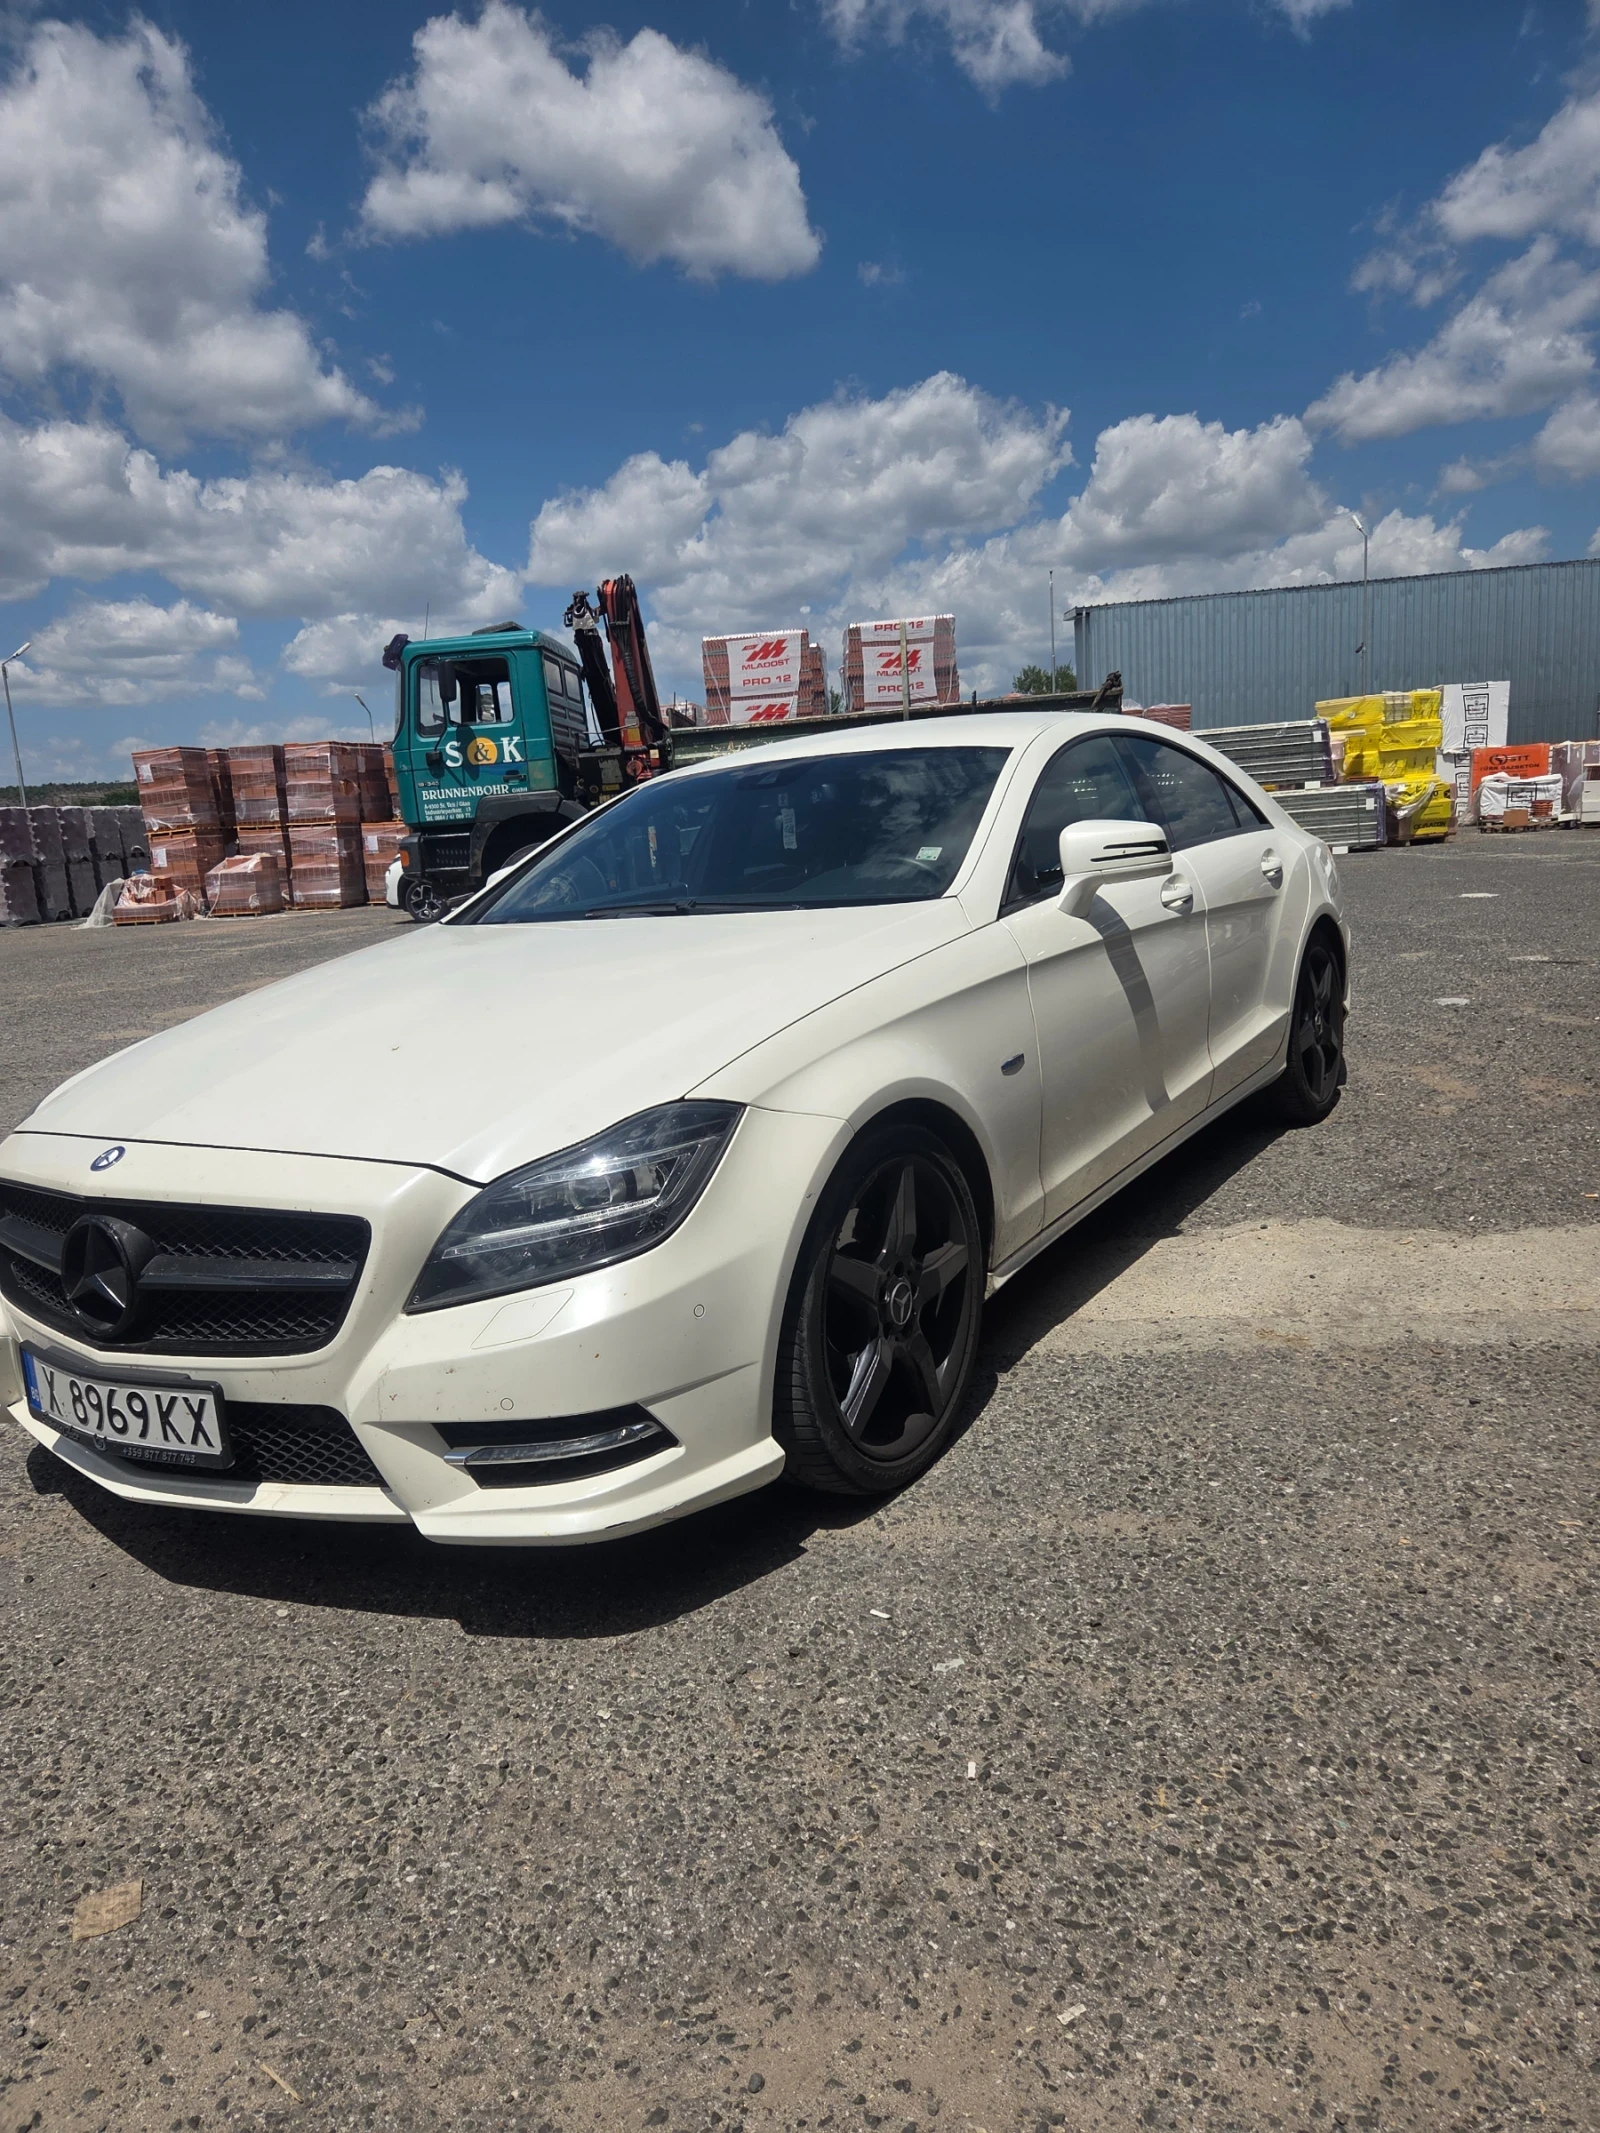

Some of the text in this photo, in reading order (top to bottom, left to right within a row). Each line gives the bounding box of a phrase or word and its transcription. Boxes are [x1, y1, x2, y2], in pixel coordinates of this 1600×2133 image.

[909, 621, 923, 630] 12
[741, 658, 790, 671] MLADOST
[742, 674, 791, 687] PRO 12
[909, 682, 924, 691] 12
[445, 736, 525, 768] S & K
[422, 784, 509, 801] BRUNNENBOHR
[31, 1385, 40, 1402] BG
[41, 1364, 64, 1417] X
[122, 1447, 196, 1464] +359 877 877 743
